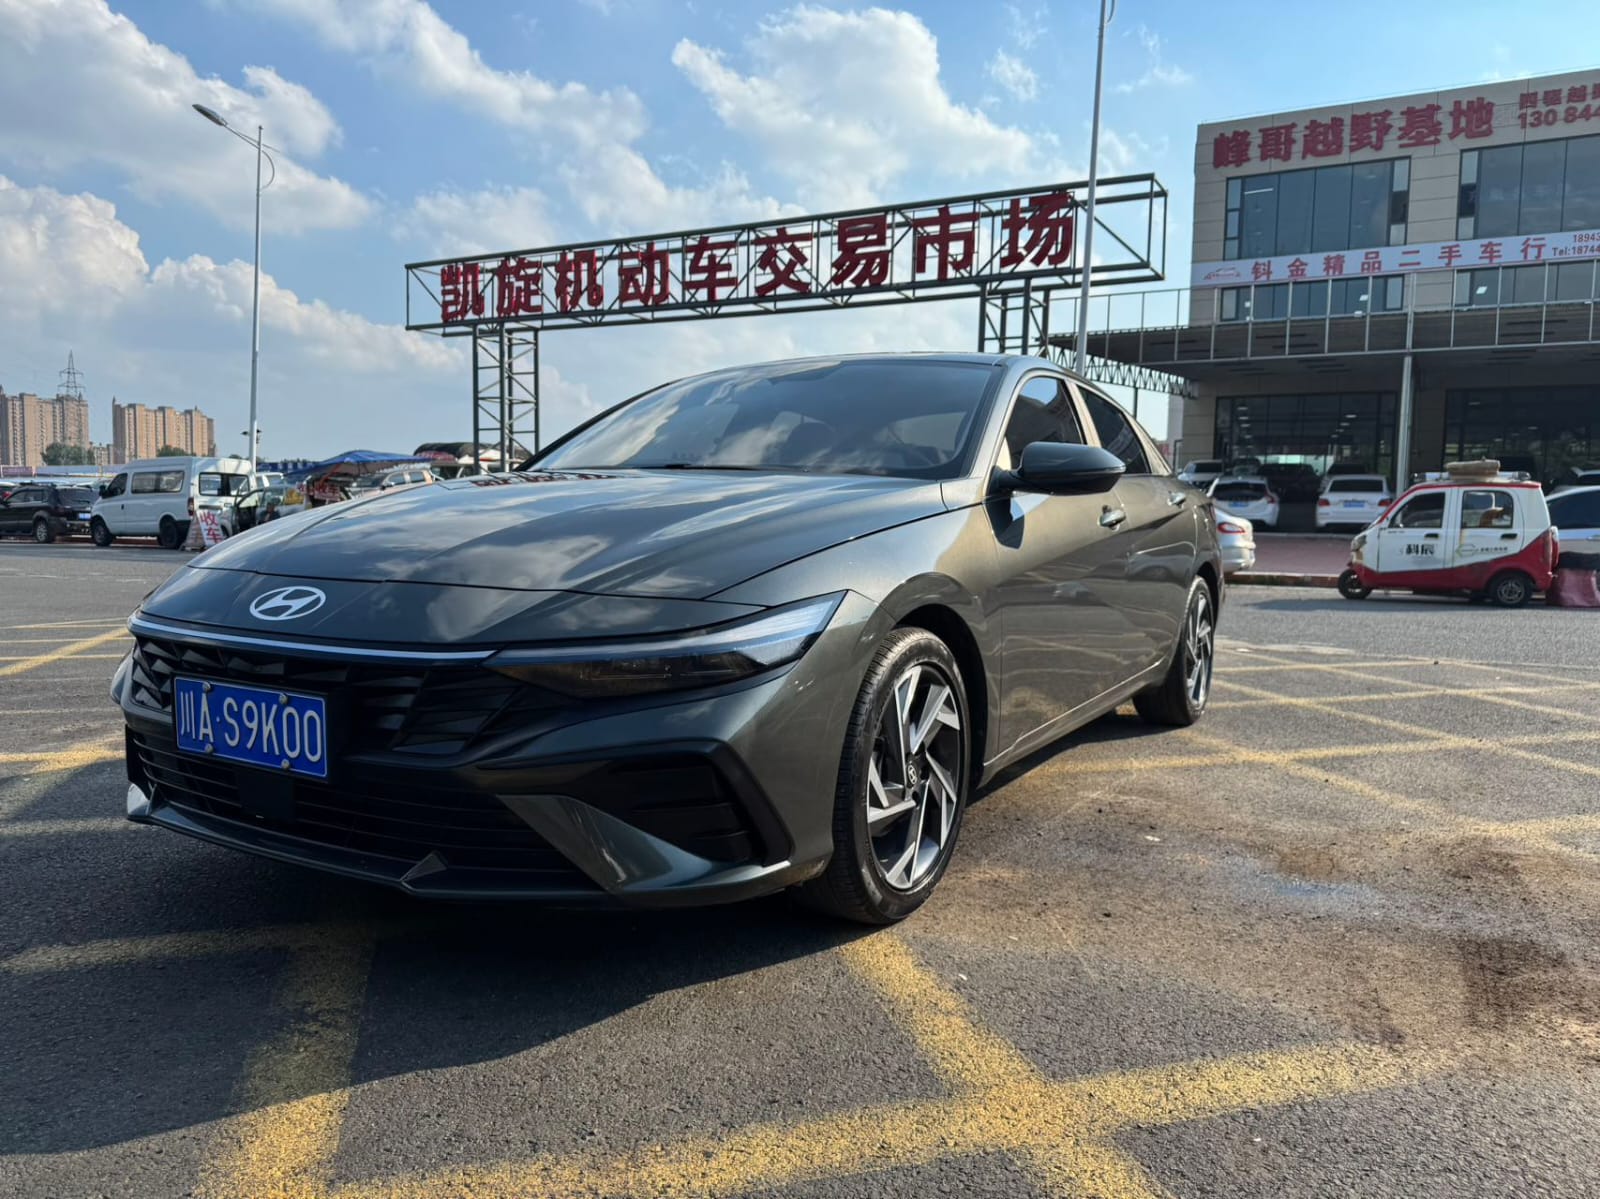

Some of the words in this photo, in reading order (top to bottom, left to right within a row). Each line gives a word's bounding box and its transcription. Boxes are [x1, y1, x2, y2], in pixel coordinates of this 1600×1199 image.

[1213, 97, 1495, 168] 峰哥越野基地
[440, 189, 1076, 322] 凯旋机动车交易市场
